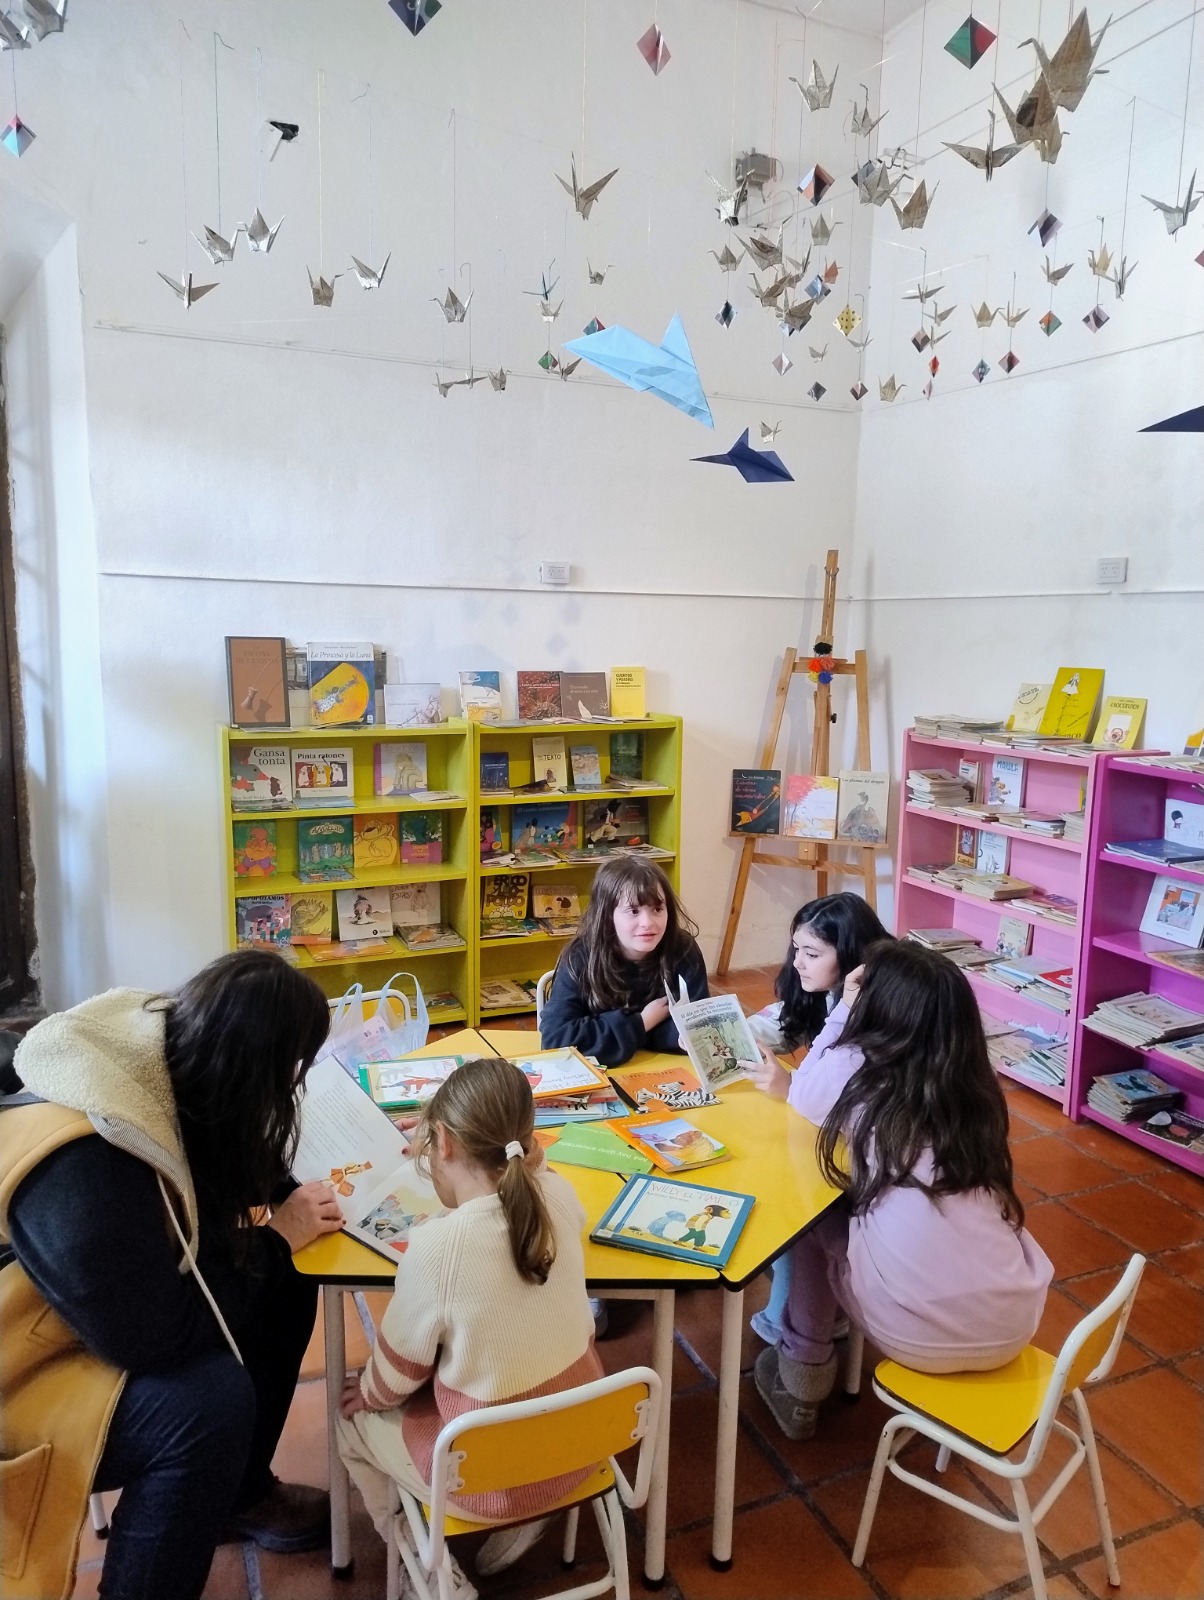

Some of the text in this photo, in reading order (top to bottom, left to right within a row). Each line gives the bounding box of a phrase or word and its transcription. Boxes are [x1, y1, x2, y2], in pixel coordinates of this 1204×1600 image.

[253, 747, 286, 757] Gansa
[258, 757, 286, 765] tonta
[598, 1147, 616, 1155] gato
[652, 1183, 680, 1195] WILLY
